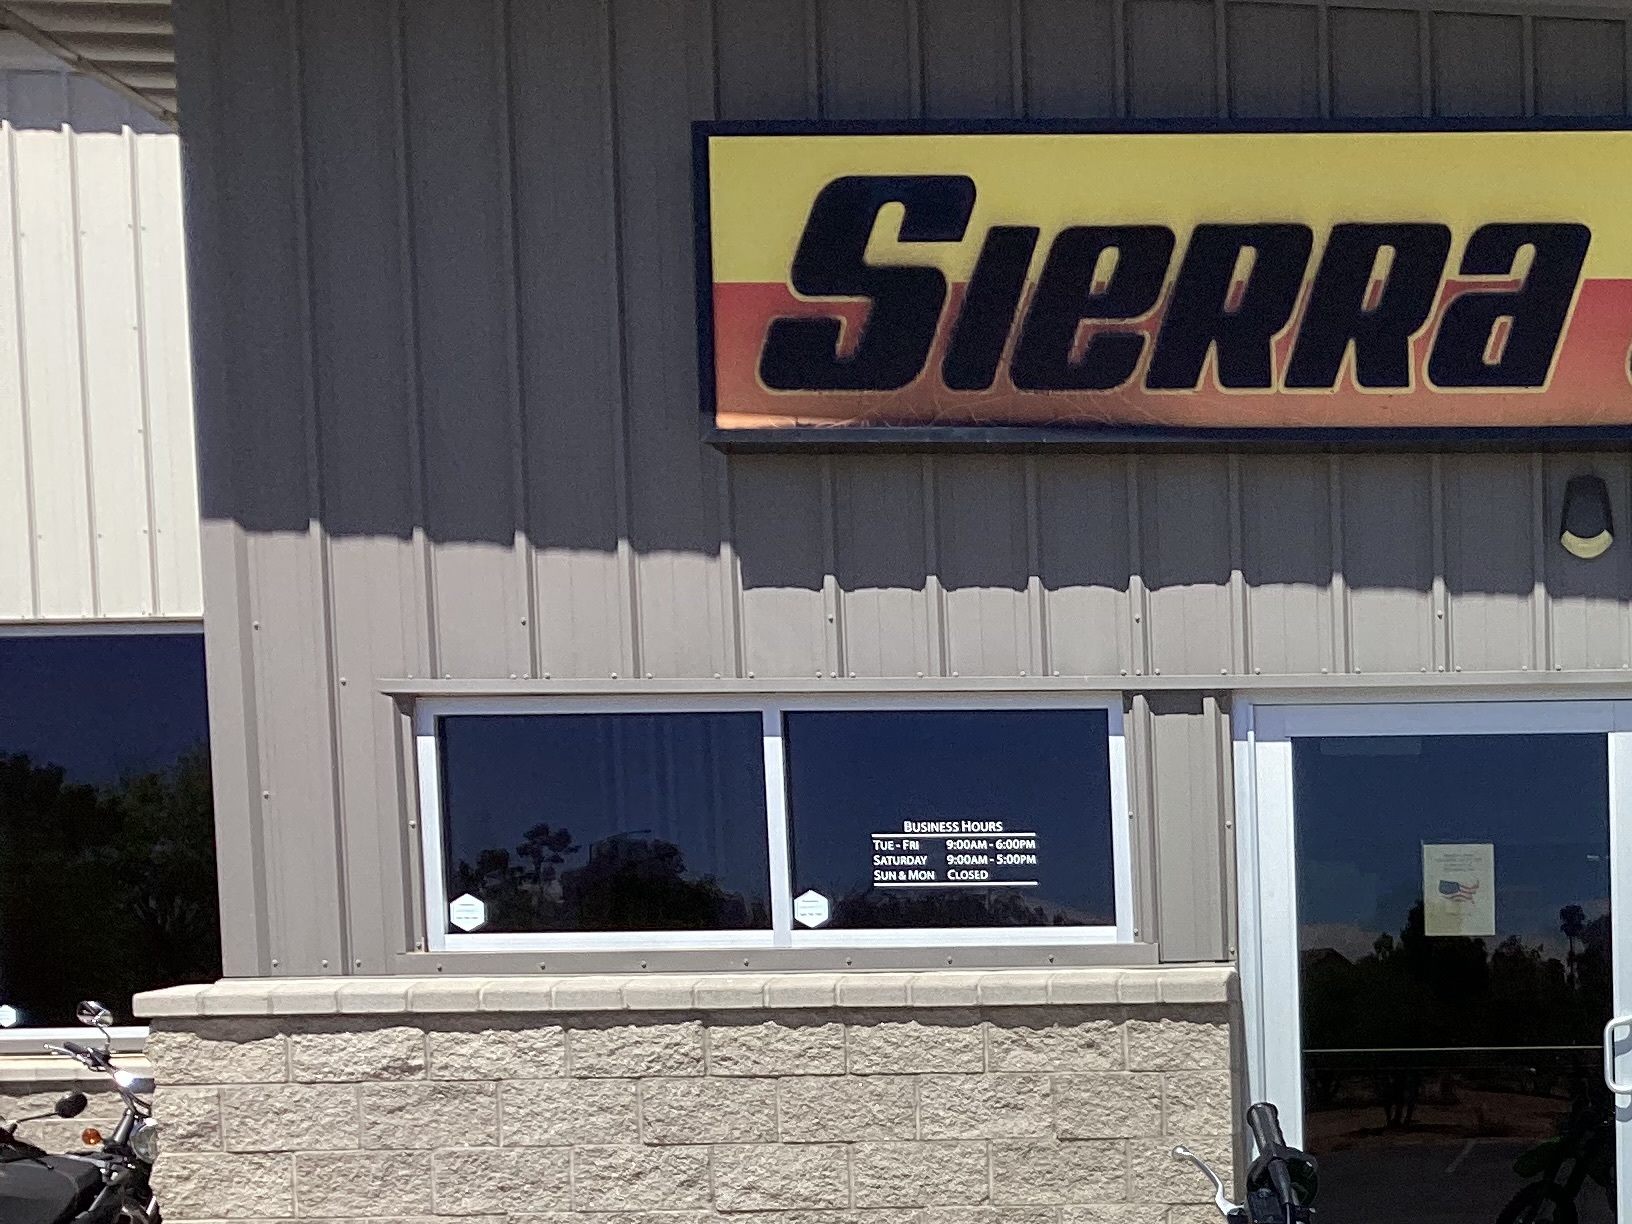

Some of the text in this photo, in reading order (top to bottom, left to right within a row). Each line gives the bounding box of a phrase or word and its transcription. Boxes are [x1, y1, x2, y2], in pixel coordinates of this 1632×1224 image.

[946, 840, 986, 850] 9:00AM
[995, 839, 1036, 850] 6:00PM
[946, 854, 987, 865] 9:00AM
[996, 854, 1037, 864] 5:00PM
